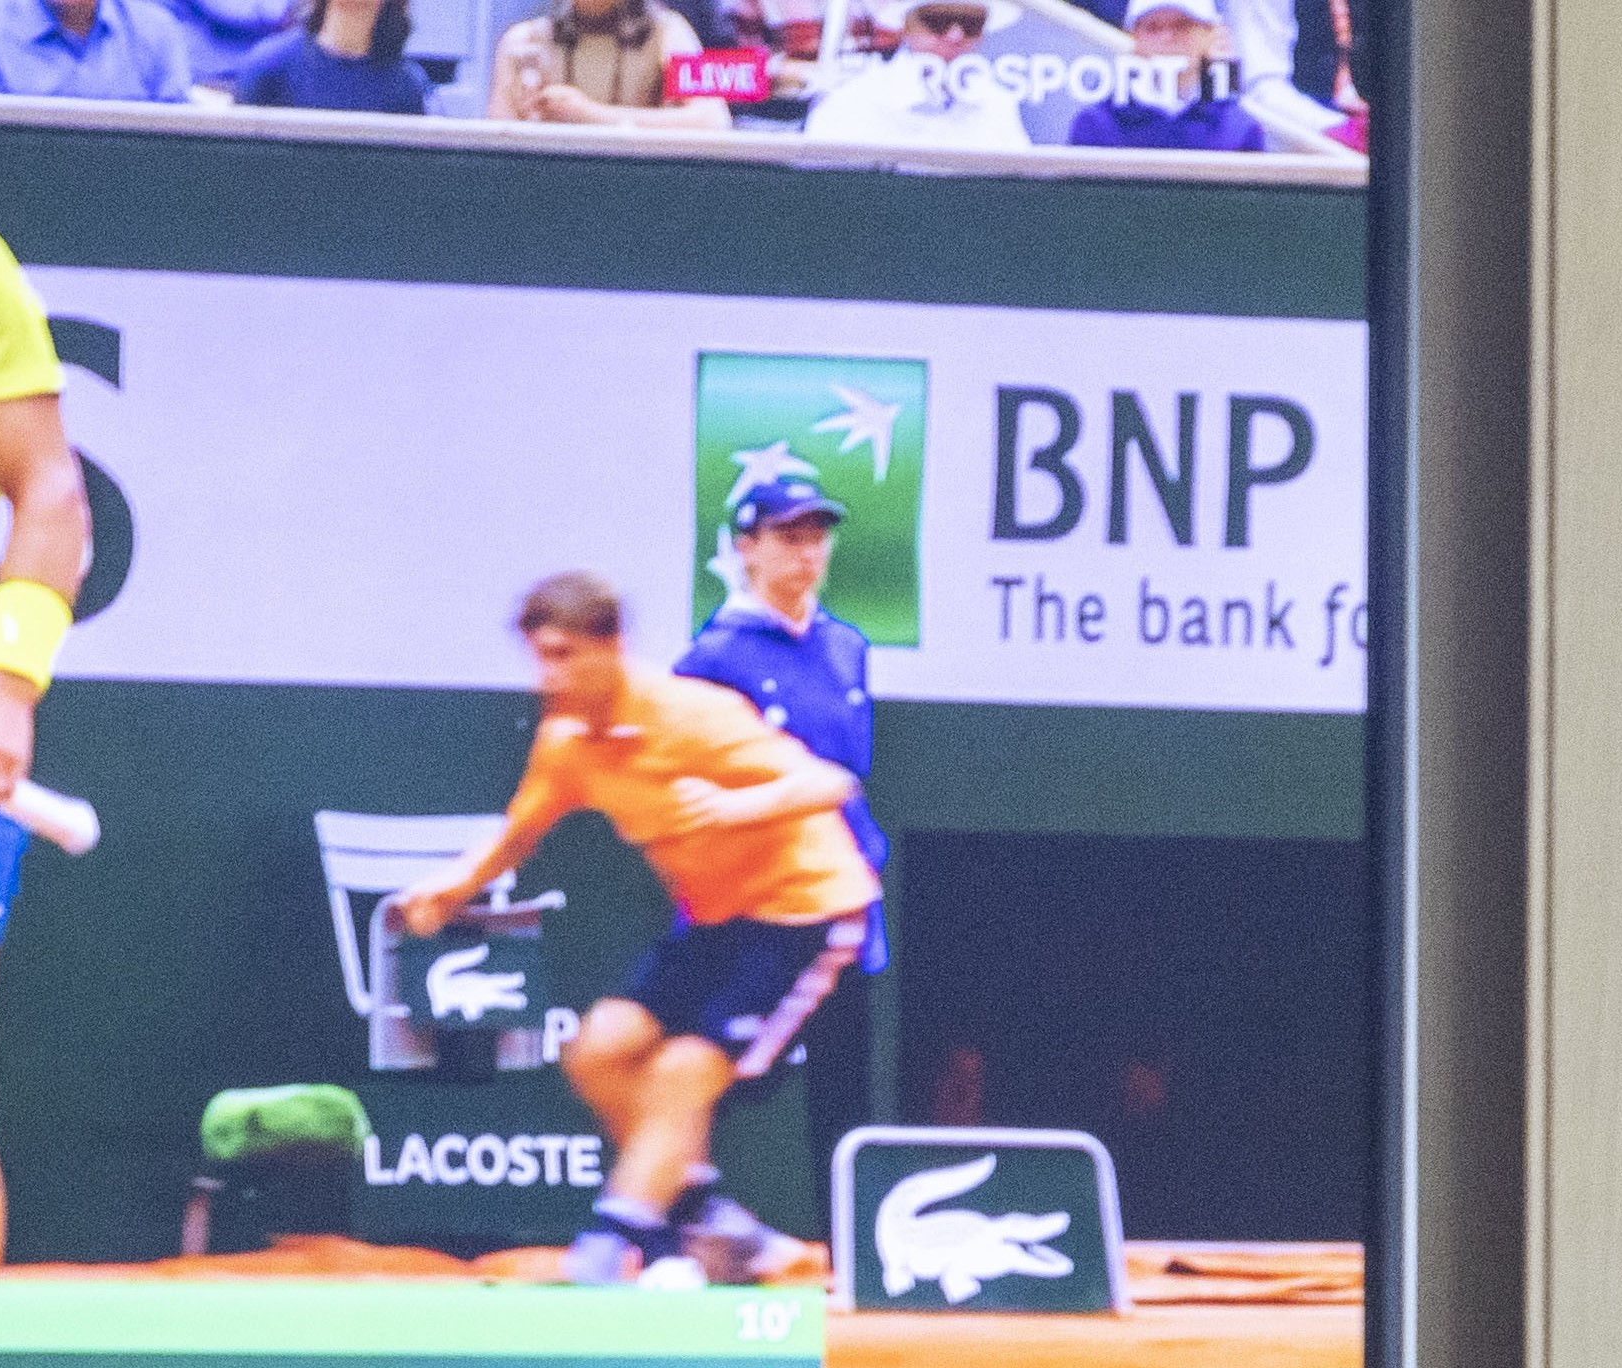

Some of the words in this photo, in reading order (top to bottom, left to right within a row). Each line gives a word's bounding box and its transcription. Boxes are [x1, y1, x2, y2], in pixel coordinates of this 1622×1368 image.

[678, 62, 758, 95] LIVE
[838, 53, 1189, 104] ROSPORT
[1207, 60, 1231, 101] 1
[990, 384, 1316, 549] BNP
[990, 575, 1108, 645] The
[1139, 577, 1296, 651] bank
[363, 1133, 604, 1187] LACOSTE
